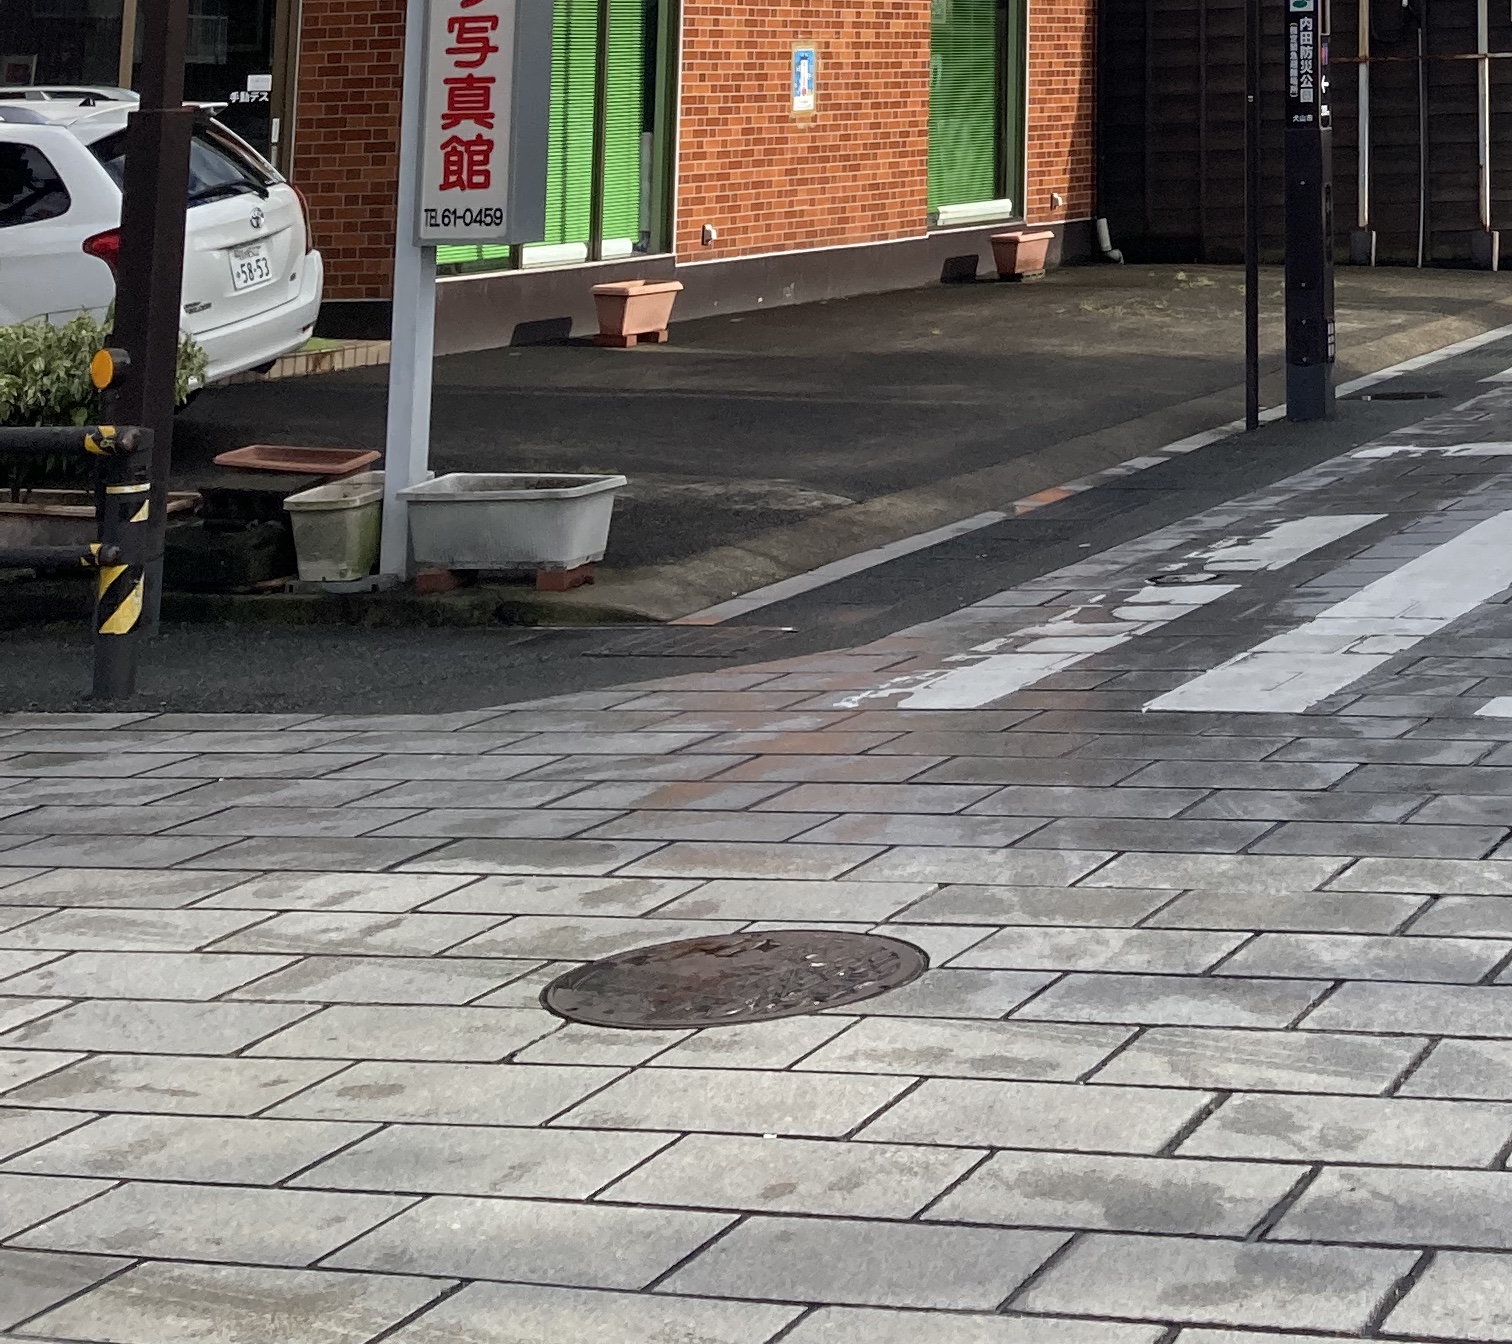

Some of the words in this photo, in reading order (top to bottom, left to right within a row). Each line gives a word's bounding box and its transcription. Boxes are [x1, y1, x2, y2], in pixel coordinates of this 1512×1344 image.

[1300, 17, 1313, 103] 内田防災公園
[424, 208, 441, 228] TEL
[441, 207, 504, 227] 61-0459
